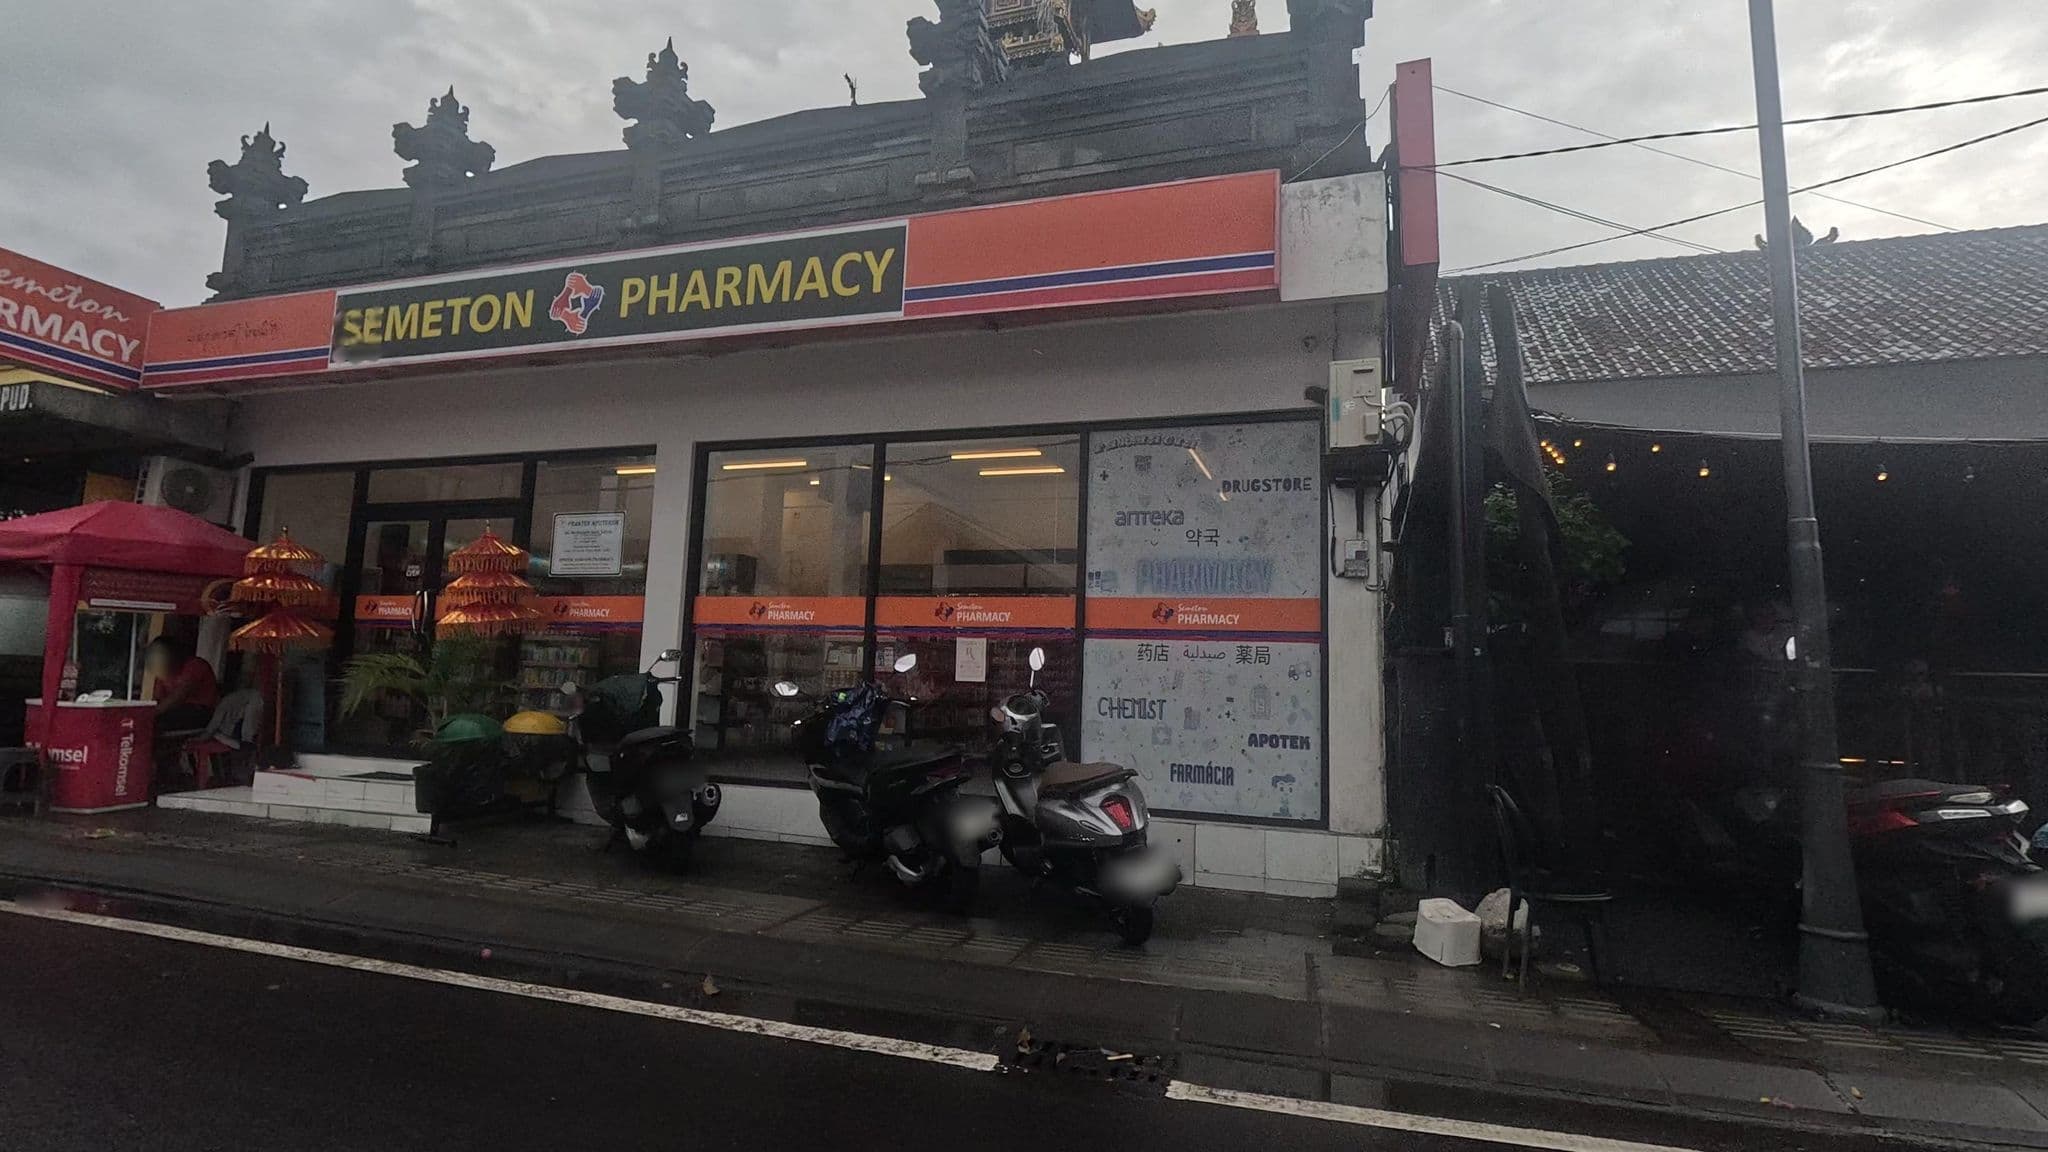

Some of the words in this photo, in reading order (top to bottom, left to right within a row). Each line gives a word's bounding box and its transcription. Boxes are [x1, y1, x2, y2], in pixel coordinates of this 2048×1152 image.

[341, 288, 535, 346] SEMETON
[619, 247, 896, 318] PHARMACY
[1221, 477, 1312, 492] DRUGSTORE
[1114, 508, 1184, 527] аптека
[1185, 528, 1221, 547] 약국
[569, 608, 610, 617] PHARMACY
[767, 610, 815, 620] PHARMACY
[956, 611, 1011, 622] PHARMACY
[1177, 613, 1240, 625] PHARMACY
[1137, 643, 1169, 662] 药店
[1182, 645, 1226, 661] صيدلية
[1235, 645, 1271, 665] 薬局
[1097, 697, 1166, 720] CHEMIST
[1248, 733, 1311, 750] APOTEK
[115, 733, 134, 797] Telkomsel
[1170, 761, 1234, 786] FARMÁCIA
